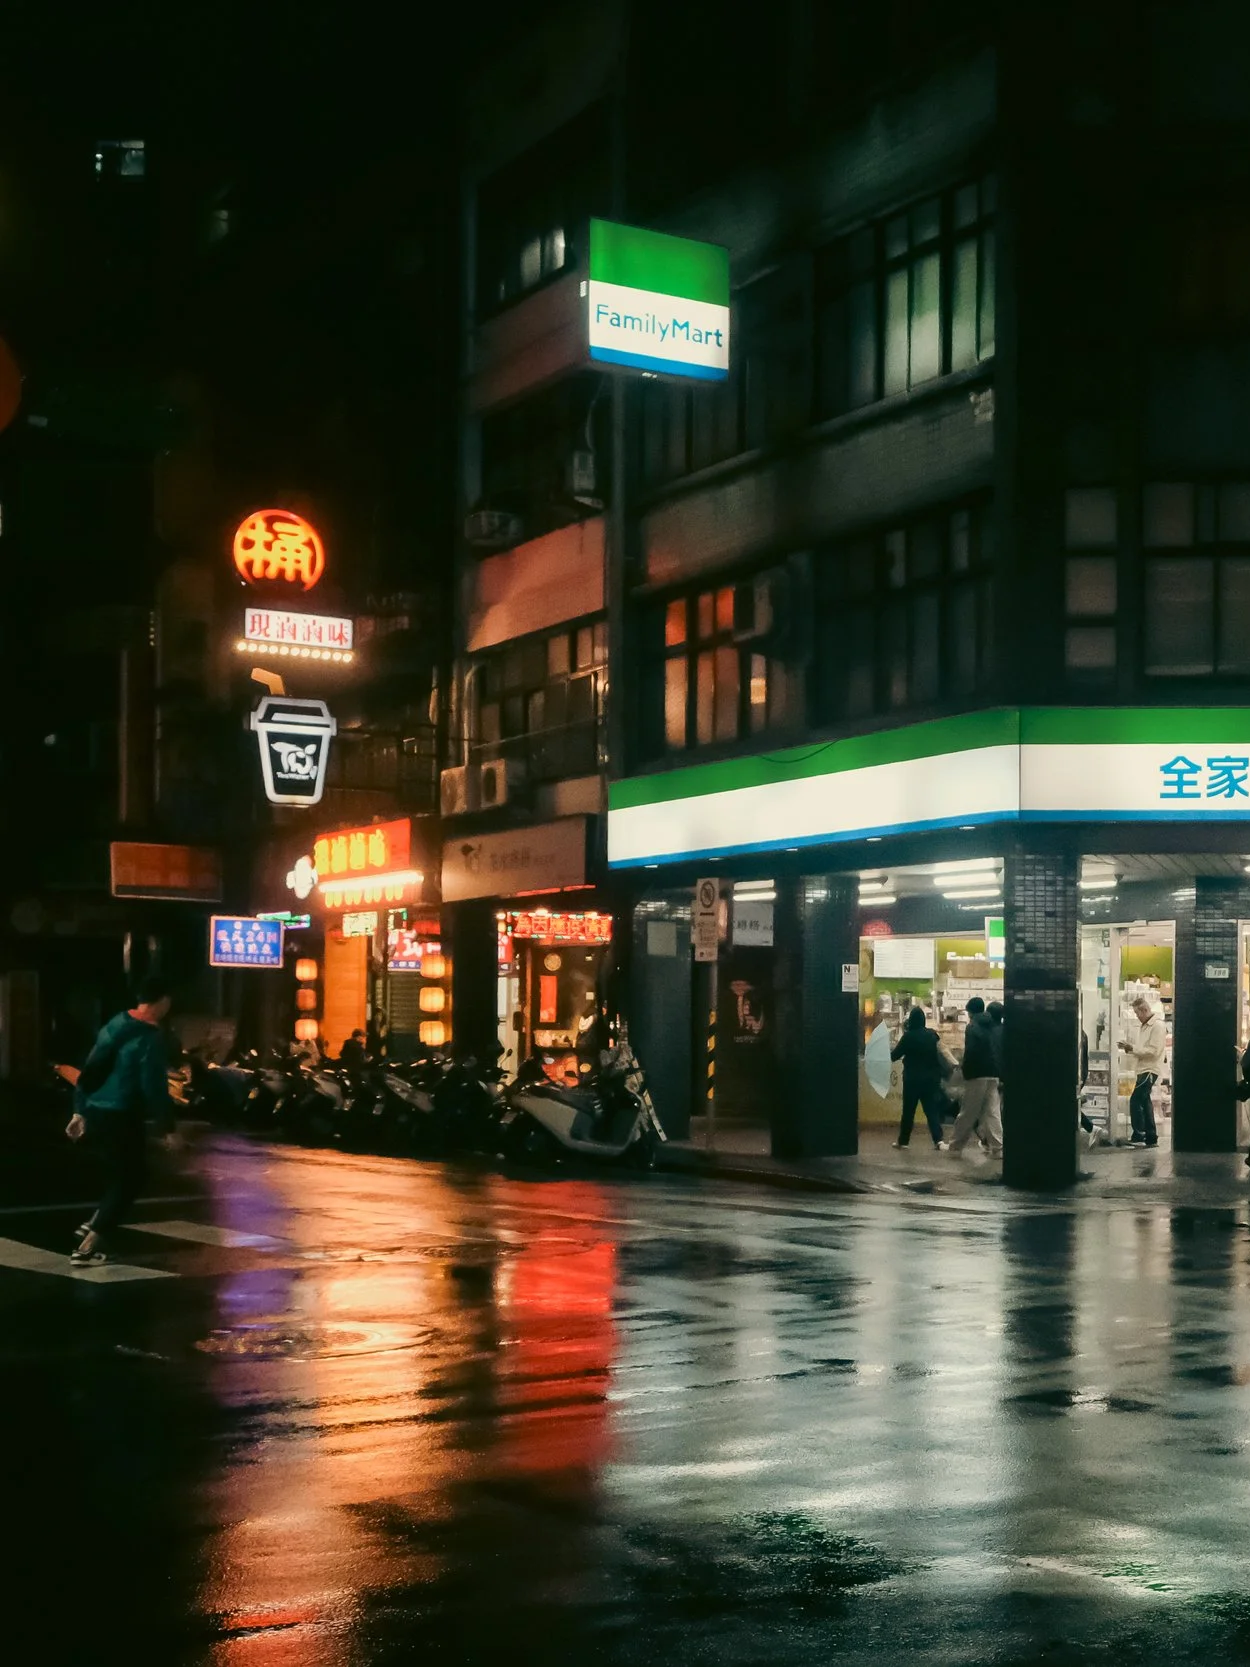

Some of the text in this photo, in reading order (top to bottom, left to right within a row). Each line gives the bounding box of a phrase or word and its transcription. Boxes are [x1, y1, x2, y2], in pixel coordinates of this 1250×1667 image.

[595, 303, 723, 348] FamilyMart
[241, 517, 313, 582] 桶
[1159, 755, 1250, 799] 全家
